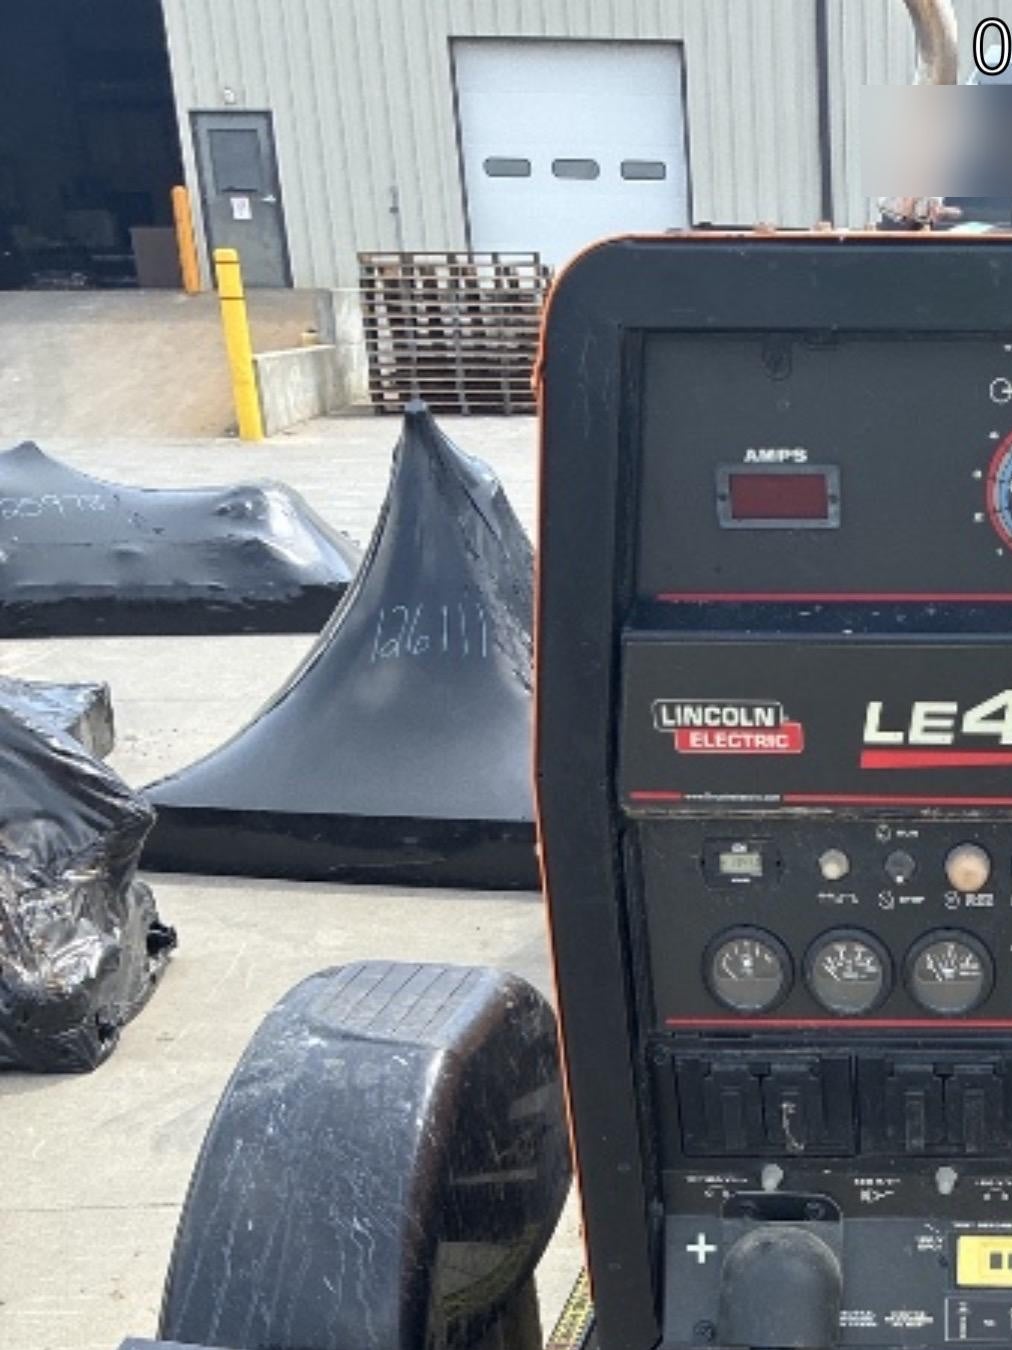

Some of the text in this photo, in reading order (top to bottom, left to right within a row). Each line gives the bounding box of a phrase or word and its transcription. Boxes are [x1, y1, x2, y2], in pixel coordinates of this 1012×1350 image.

[743, 448, 809, 463] AMPS
[661, 704, 775, 728] LINCOLN
[688, 731, 790, 749] ELECTRIC
